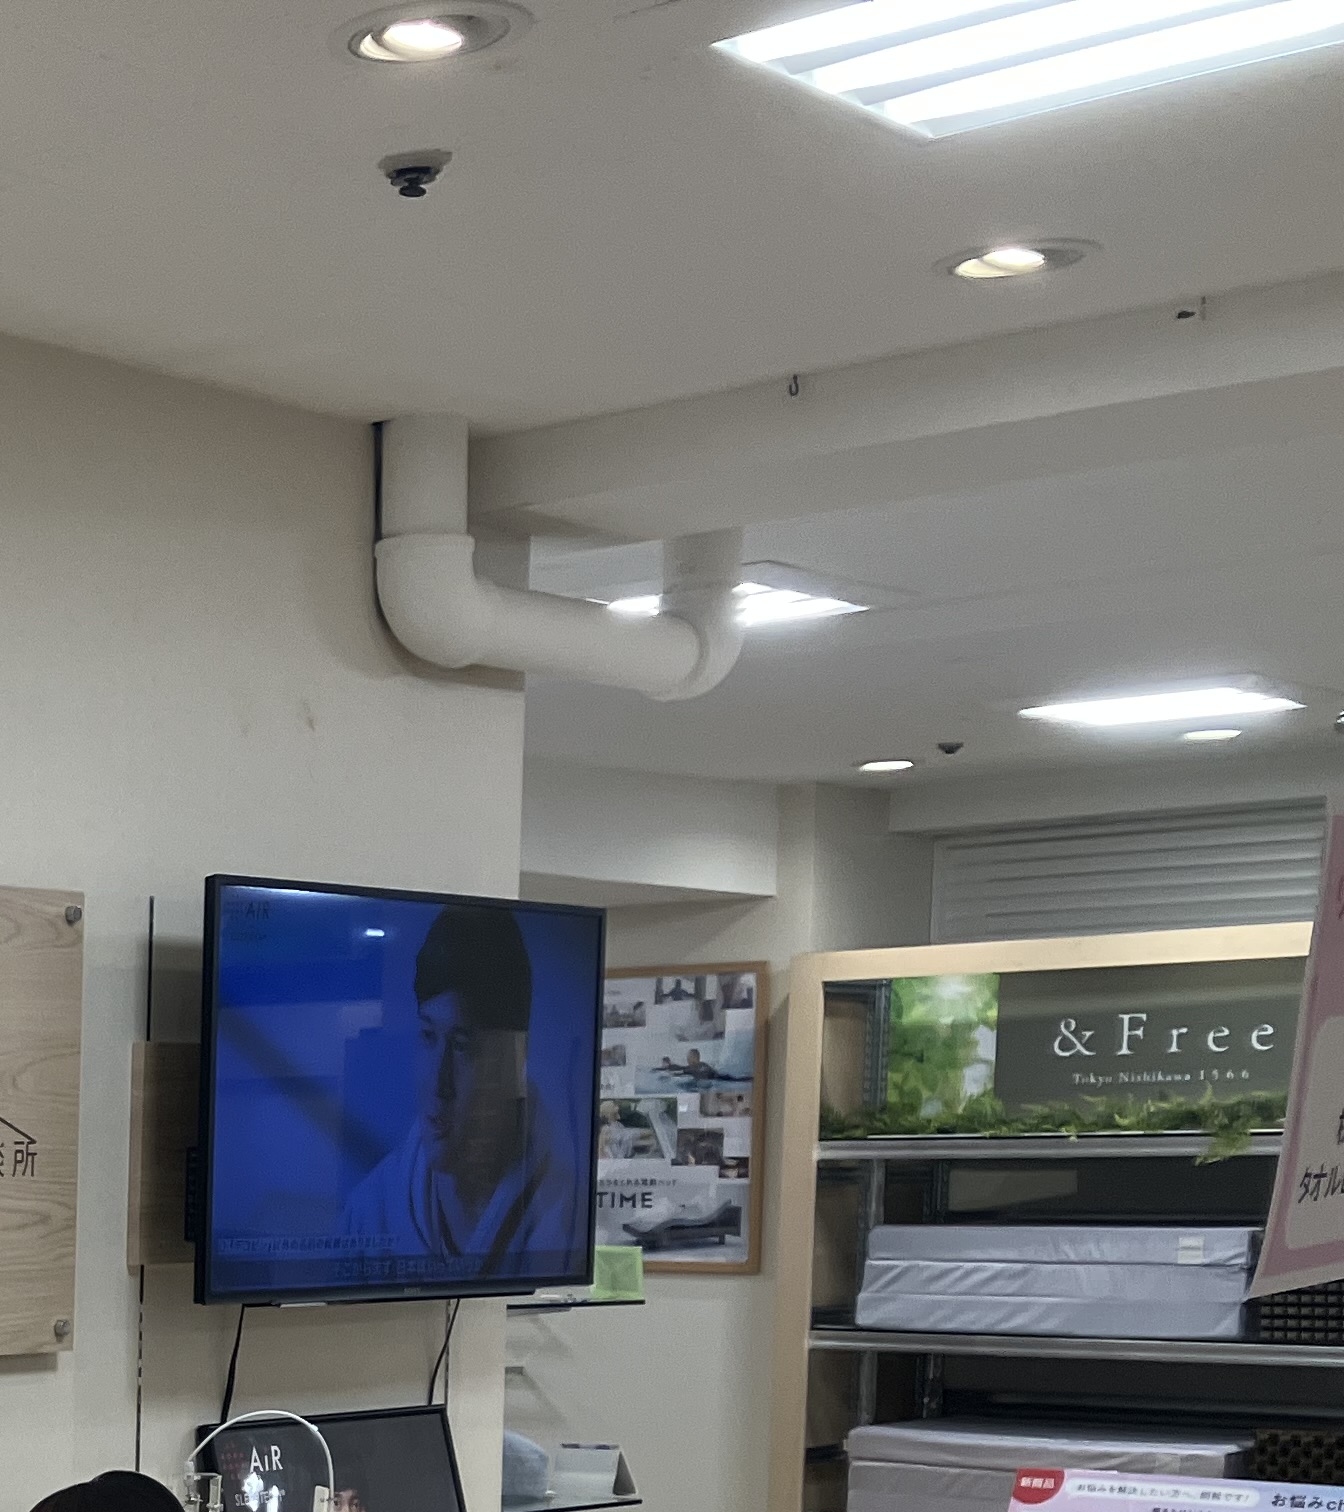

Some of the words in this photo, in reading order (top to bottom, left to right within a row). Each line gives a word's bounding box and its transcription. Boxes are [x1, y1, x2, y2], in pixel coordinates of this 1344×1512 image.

[1053, 1018, 1096, 1057] &
[1116, 1012, 1275, 1056] Free
[1073, 1072, 1112, 1087] Tokyo
[1119, 1071, 1191, 1084] Nishikawa
[597, 1191, 653, 1209] TIME
